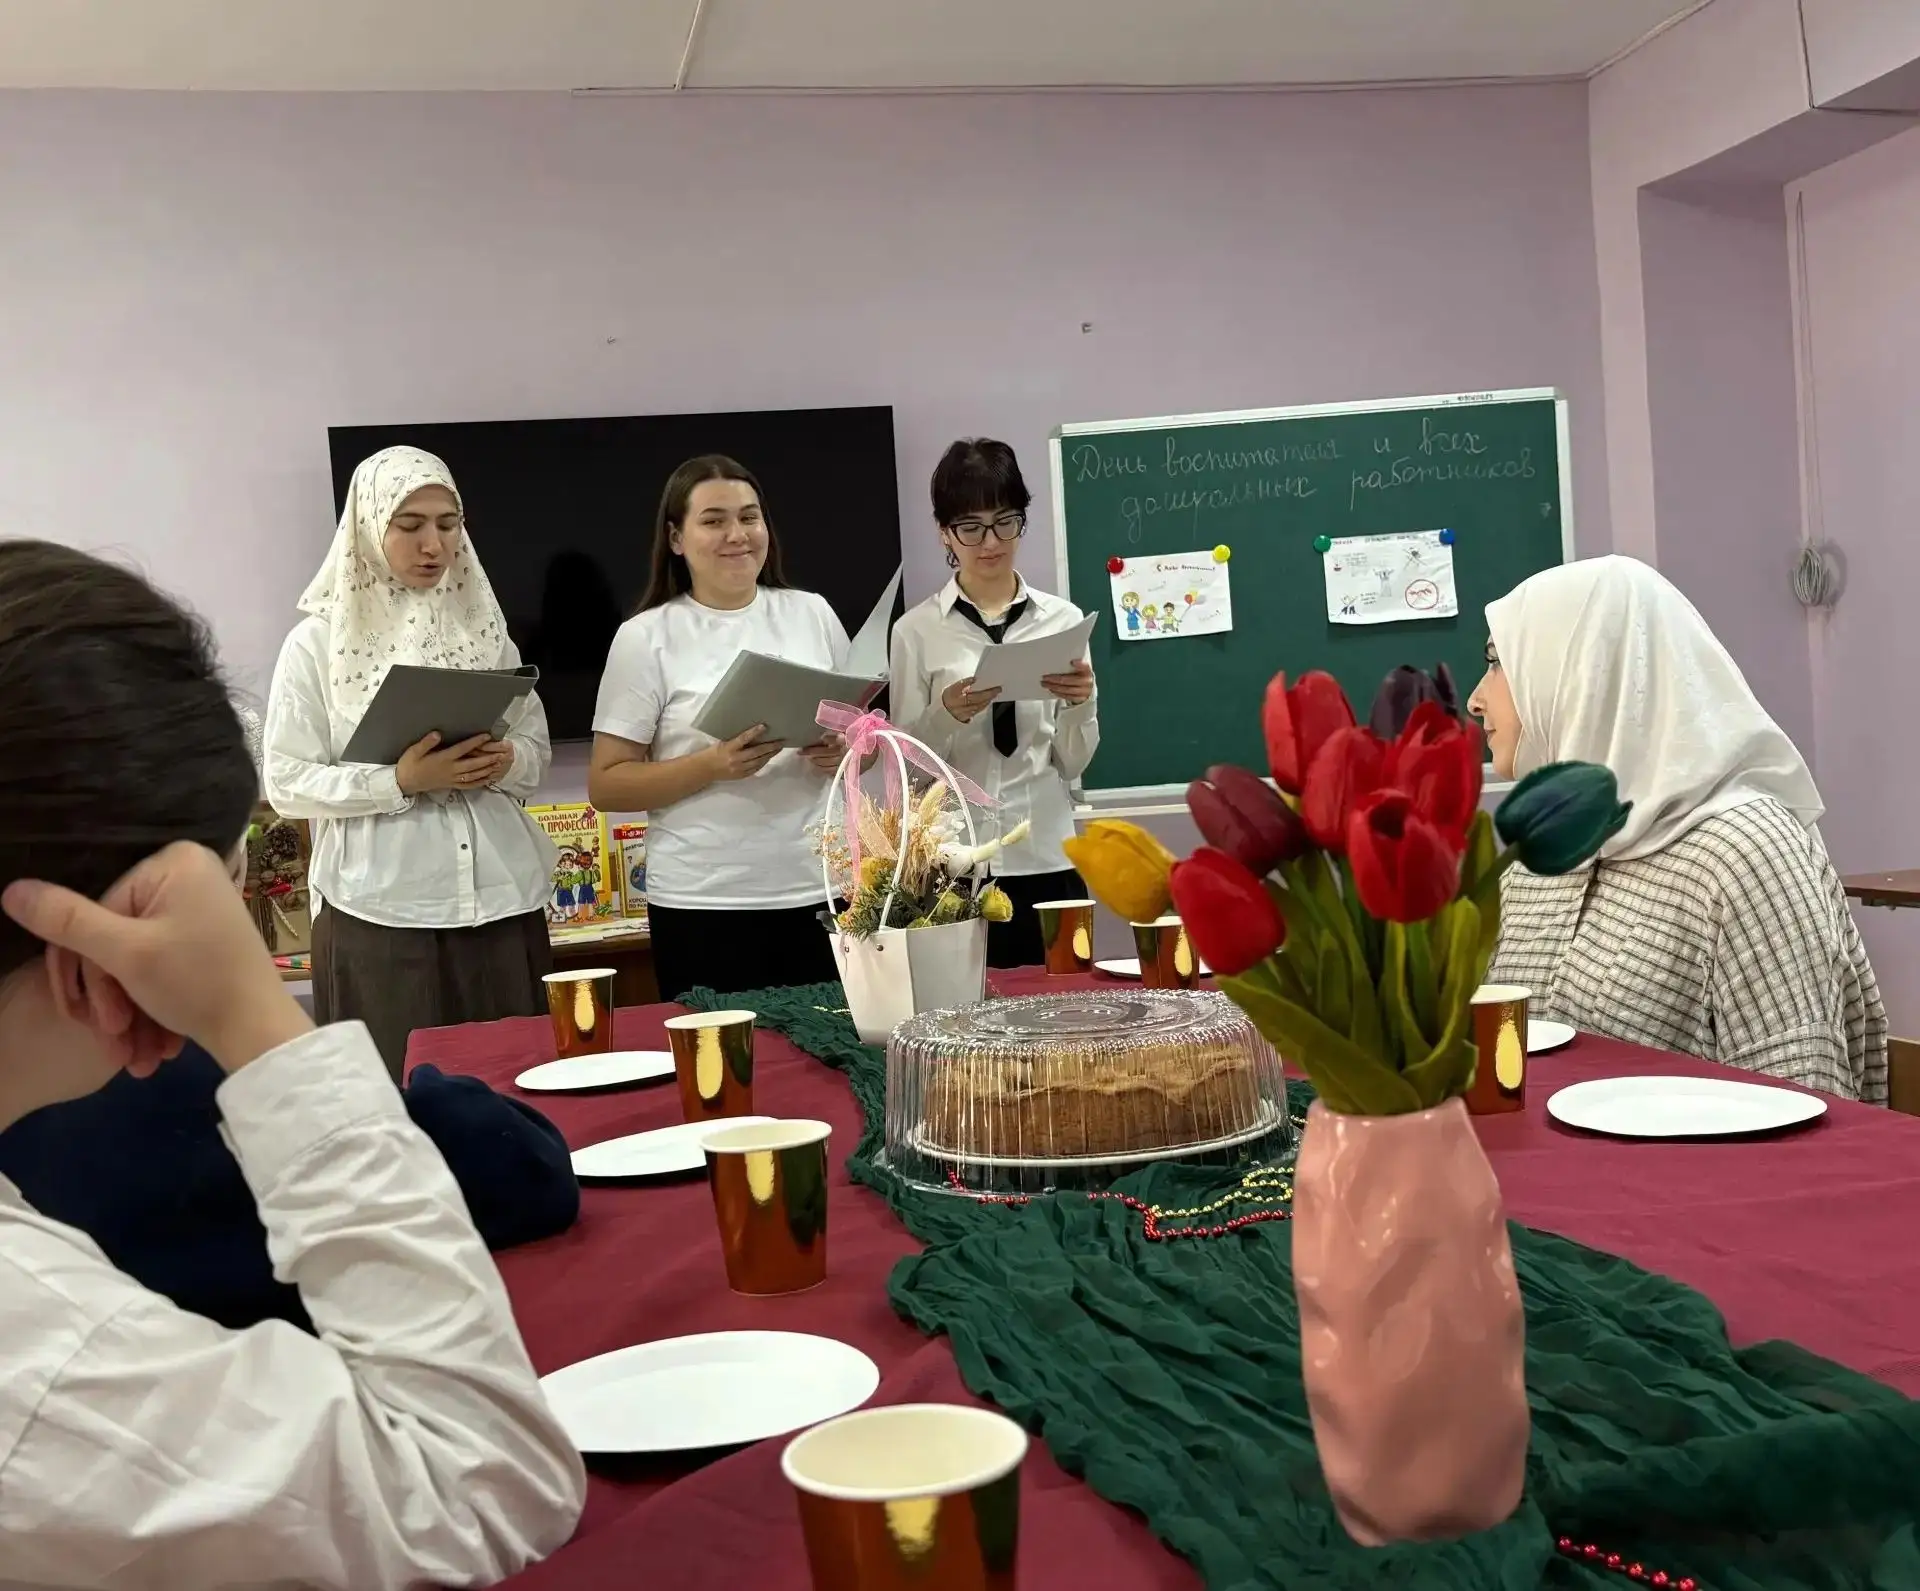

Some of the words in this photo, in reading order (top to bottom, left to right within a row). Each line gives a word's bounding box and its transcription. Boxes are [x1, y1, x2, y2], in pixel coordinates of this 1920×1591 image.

[1072, 444, 1147, 482] День
[1374, 437, 1391, 454] и
[1419, 417, 1488, 455] всех
[1350, 448, 1536, 511] работников
[538, 812, 578, 822] БОЛЬШАЯ
[547, 817, 598, 832] ПРОФЕССИЙ
